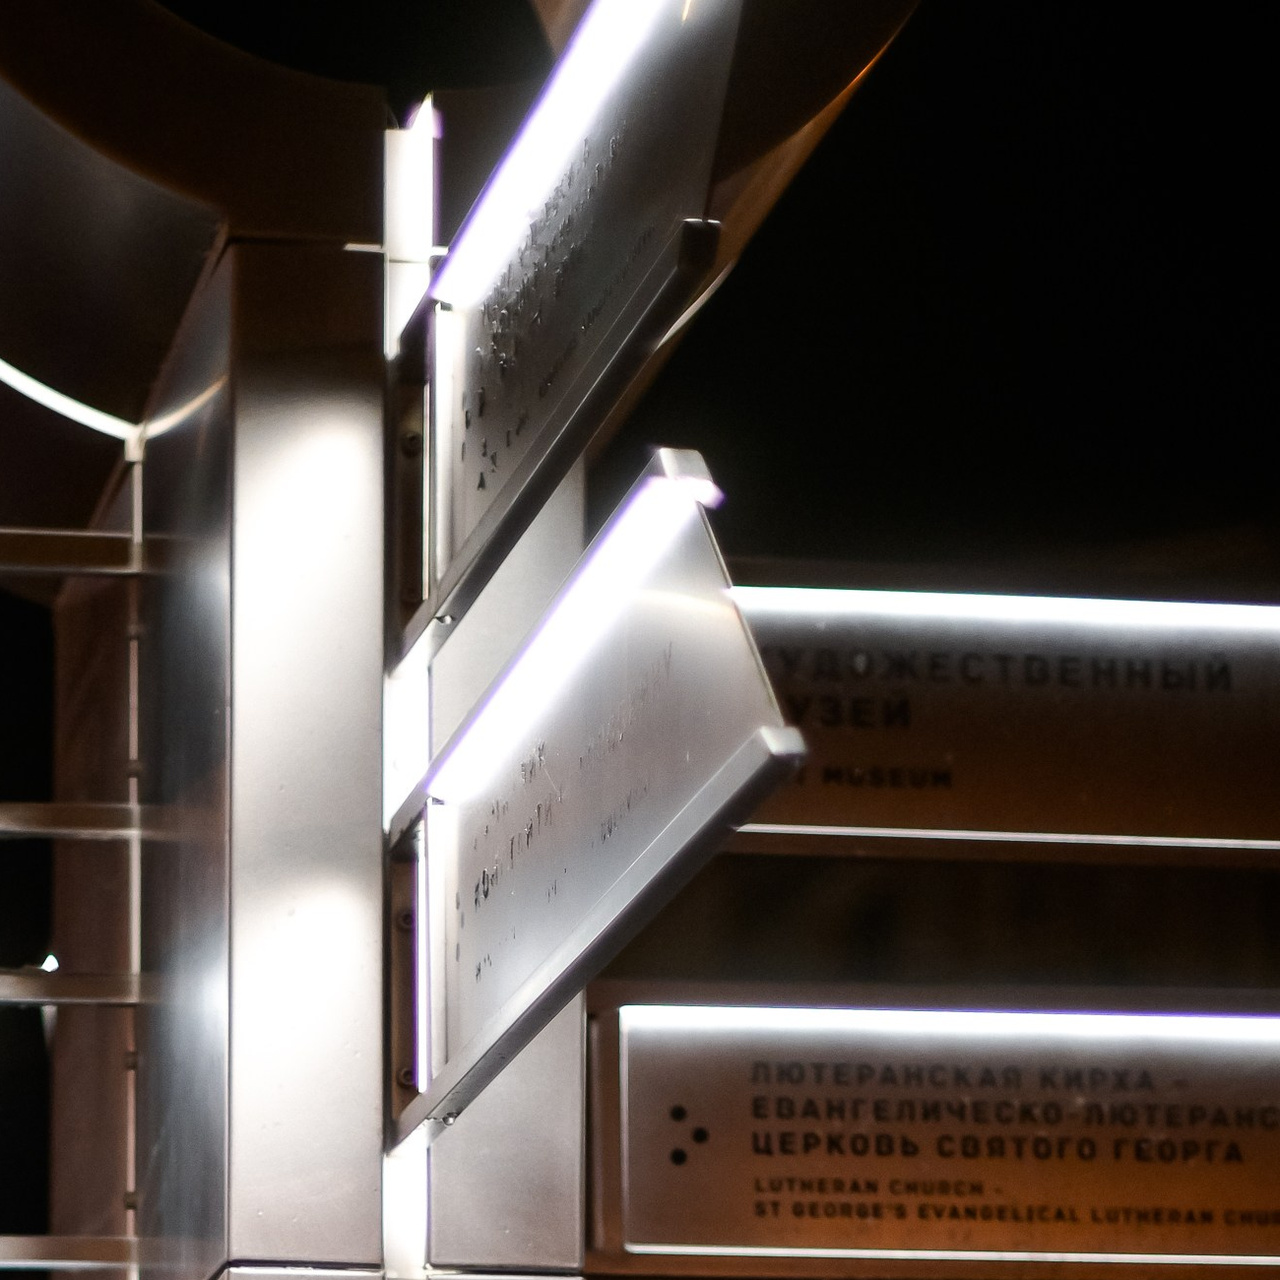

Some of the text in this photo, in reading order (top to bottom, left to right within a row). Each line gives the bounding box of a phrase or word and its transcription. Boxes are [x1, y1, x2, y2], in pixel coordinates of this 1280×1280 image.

[784, 690, 913, 730] УЗЕЙ
[822, 765, 953, 788] MUSEUM
[749, 1061, 1023, 1090] ЛЮТЕРАНСКАЯ
[1040, 1066, 1156, 1092] КИРХА
[751, 1131, 1245, 1165] ЦЕРКОВЬ СВЯТОГО ГЕОРГА
[754, 1176, 879, 1196] LUTHERAN
[889, 1178, 985, 1197] CHURCH
[754, 1200, 782, 1219] ST
[918, 1203, 1080, 1224] EVANGELICAL
[1091, 1205, 1214, 1226] LUTHERAN
